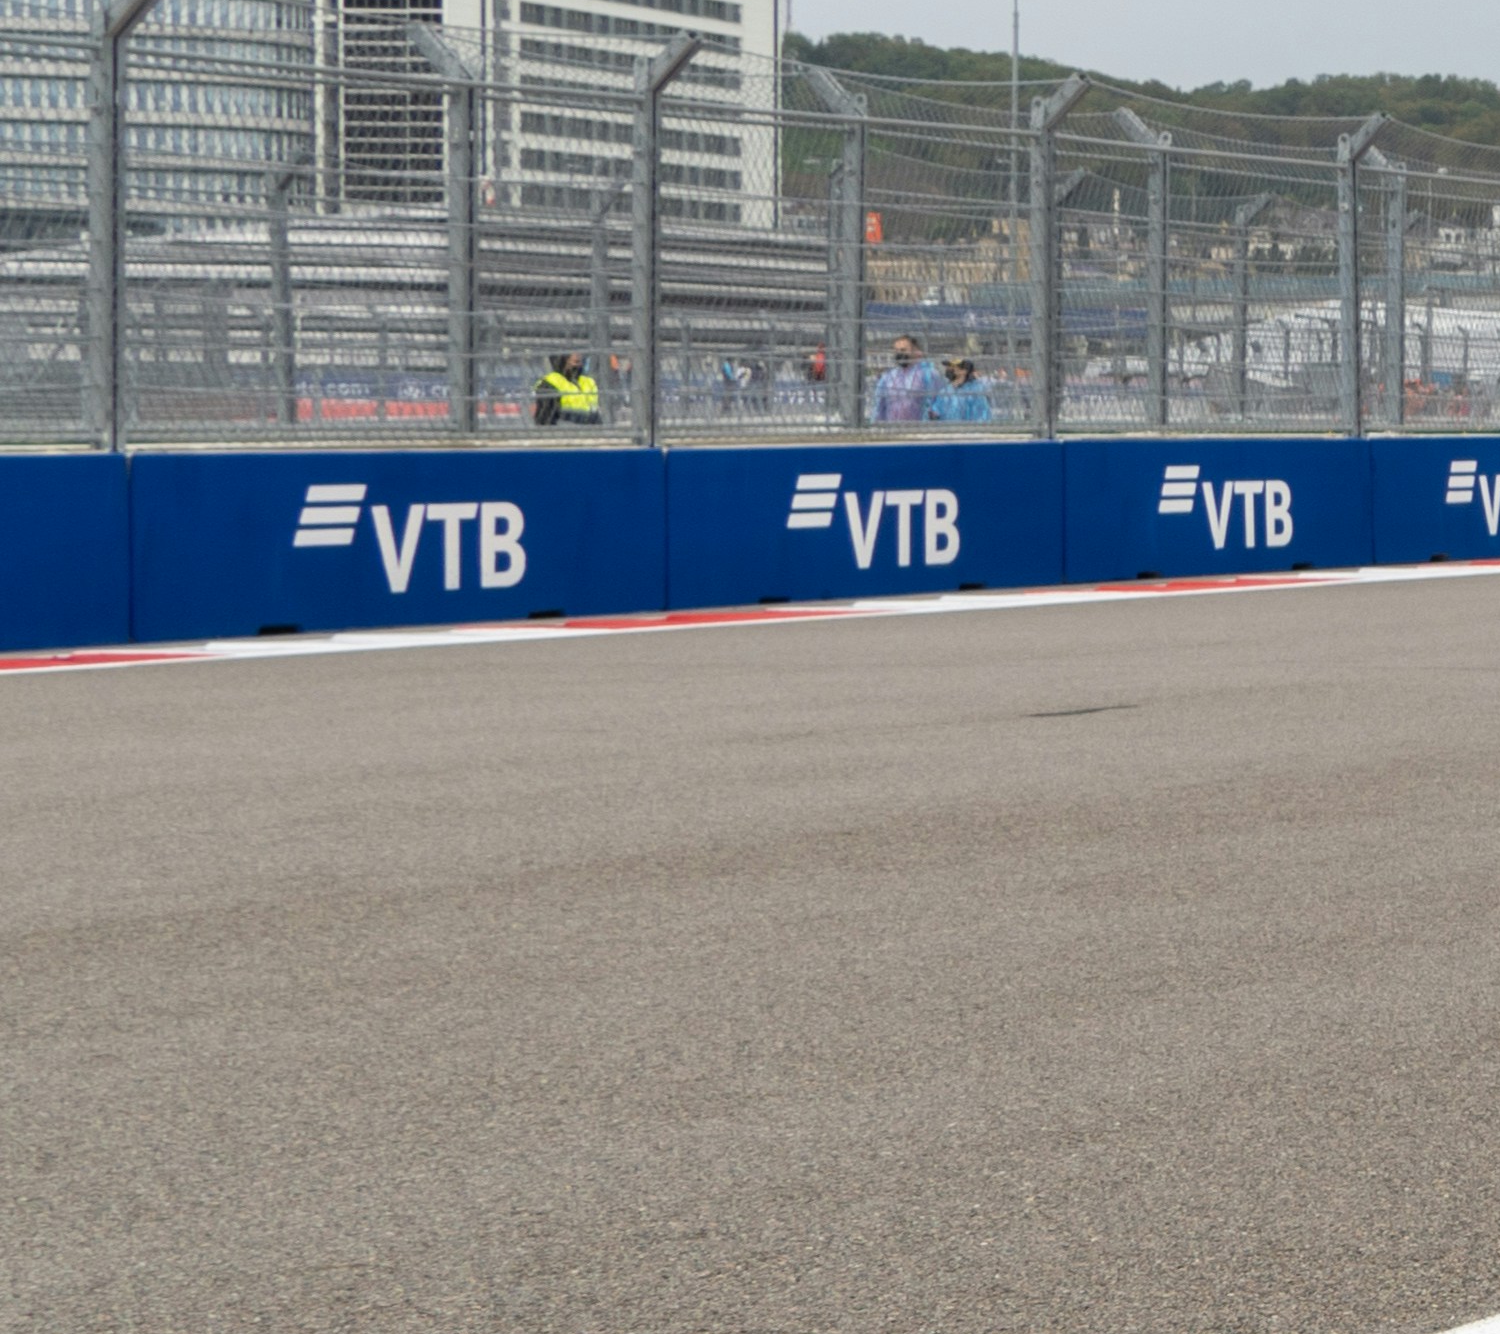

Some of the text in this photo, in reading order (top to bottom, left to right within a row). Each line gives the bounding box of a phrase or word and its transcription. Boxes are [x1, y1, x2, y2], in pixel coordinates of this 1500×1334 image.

[371, 501, 527, 593] VTB
[844, 488, 960, 569] VTB
[1202, 479, 1294, 550] VTB
